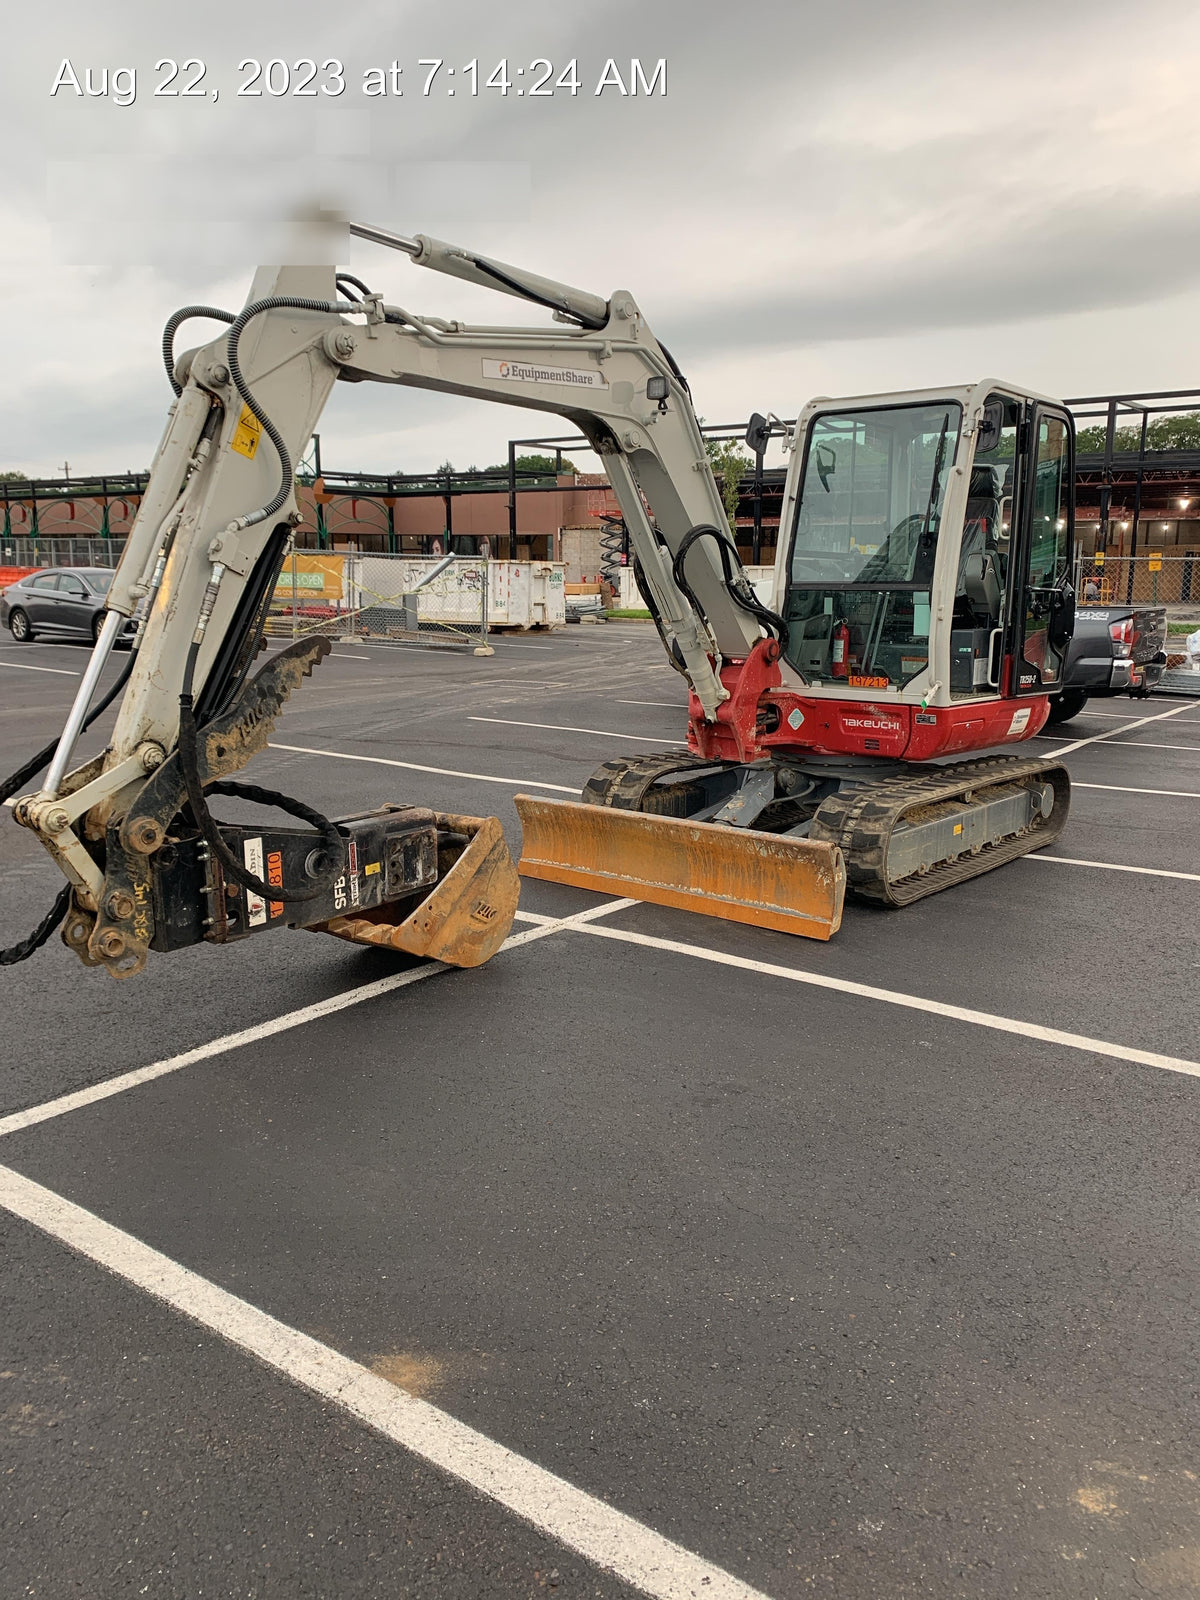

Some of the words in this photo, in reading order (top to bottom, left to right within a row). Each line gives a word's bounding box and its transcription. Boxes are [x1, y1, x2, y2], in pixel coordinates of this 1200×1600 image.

[511, 365, 593, 385] EquipmentShare
[301, 574, 323, 586] OPEN
[849, 676, 888, 688] 197213
[842, 718, 900, 730] TAKEUCHI
[334, 876, 347, 910] SFB
